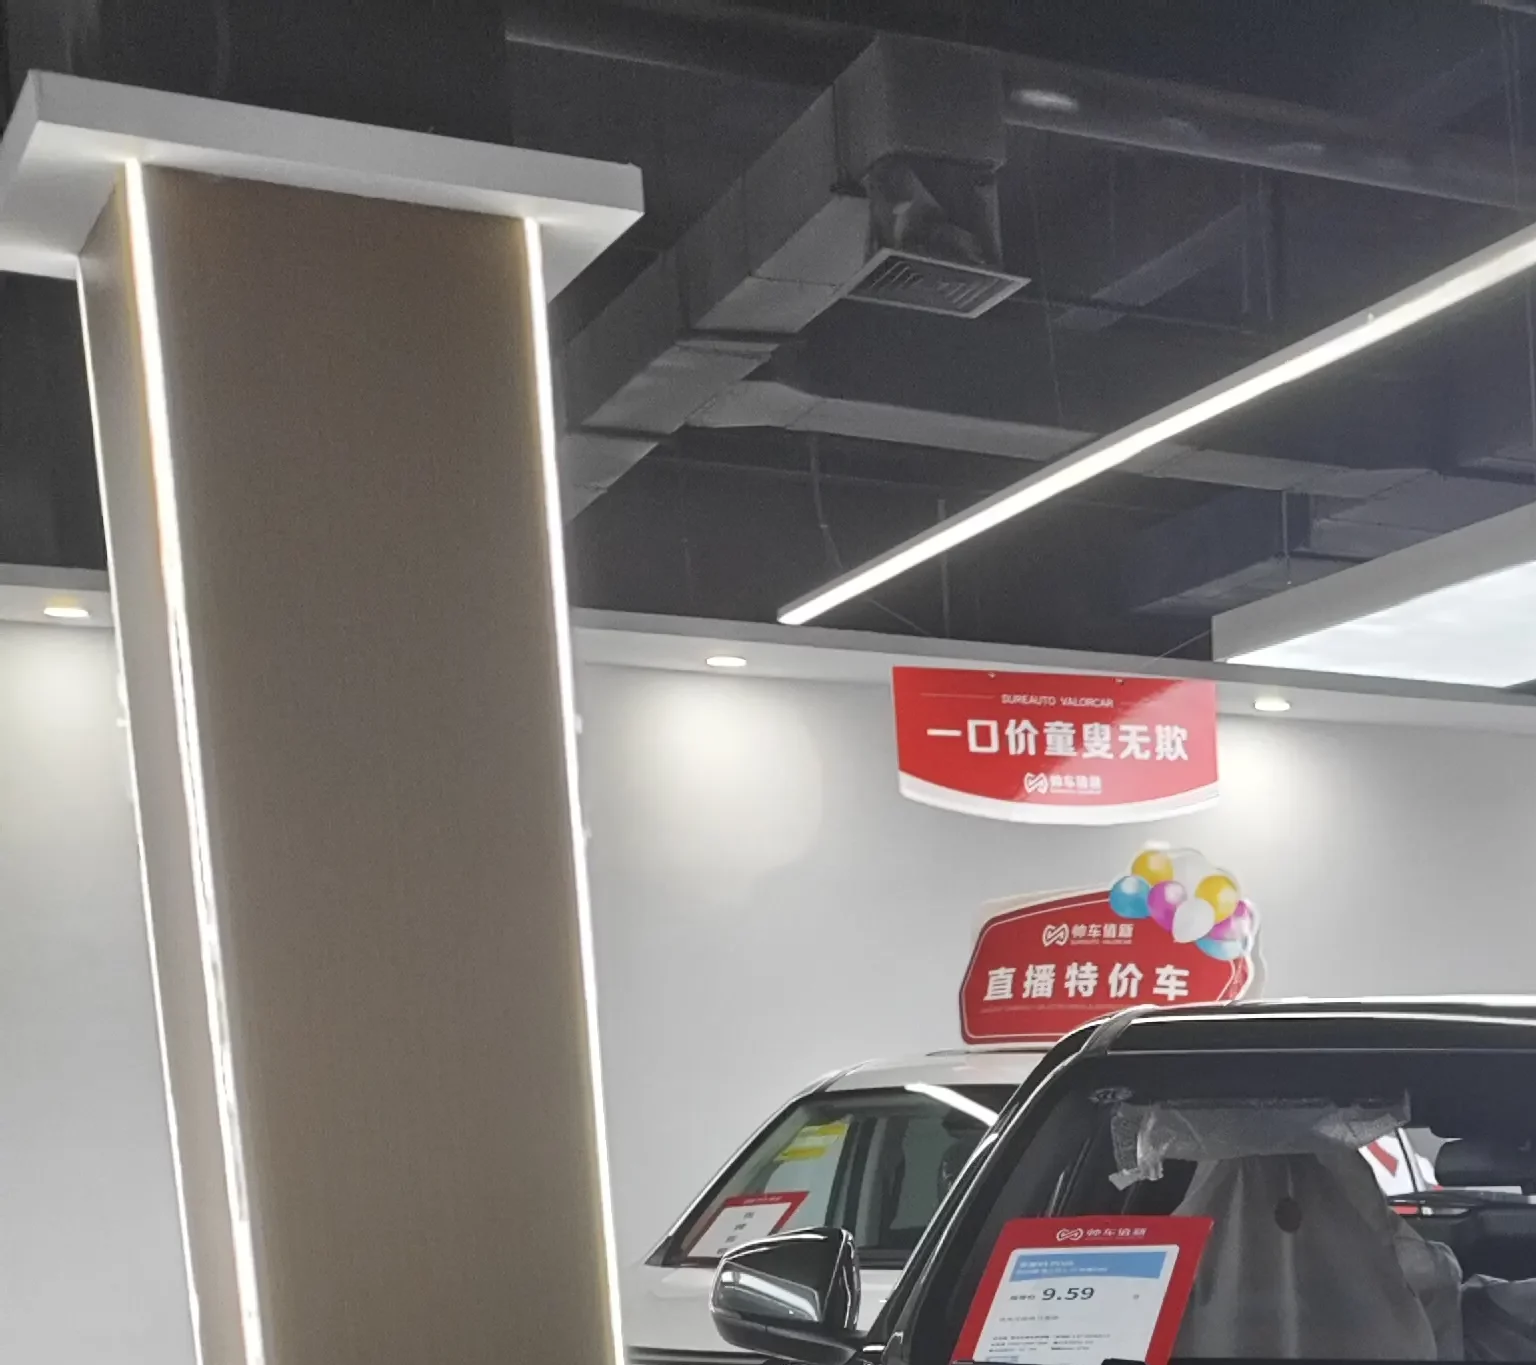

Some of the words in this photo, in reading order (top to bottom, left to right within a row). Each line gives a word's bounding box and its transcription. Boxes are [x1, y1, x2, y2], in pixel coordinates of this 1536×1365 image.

[926, 718, 1189, 762] 一口价童叟无欺
[983, 961, 1190, 1002] 直播特价车
[1041, 1287, 1095, 1301] 9.59
